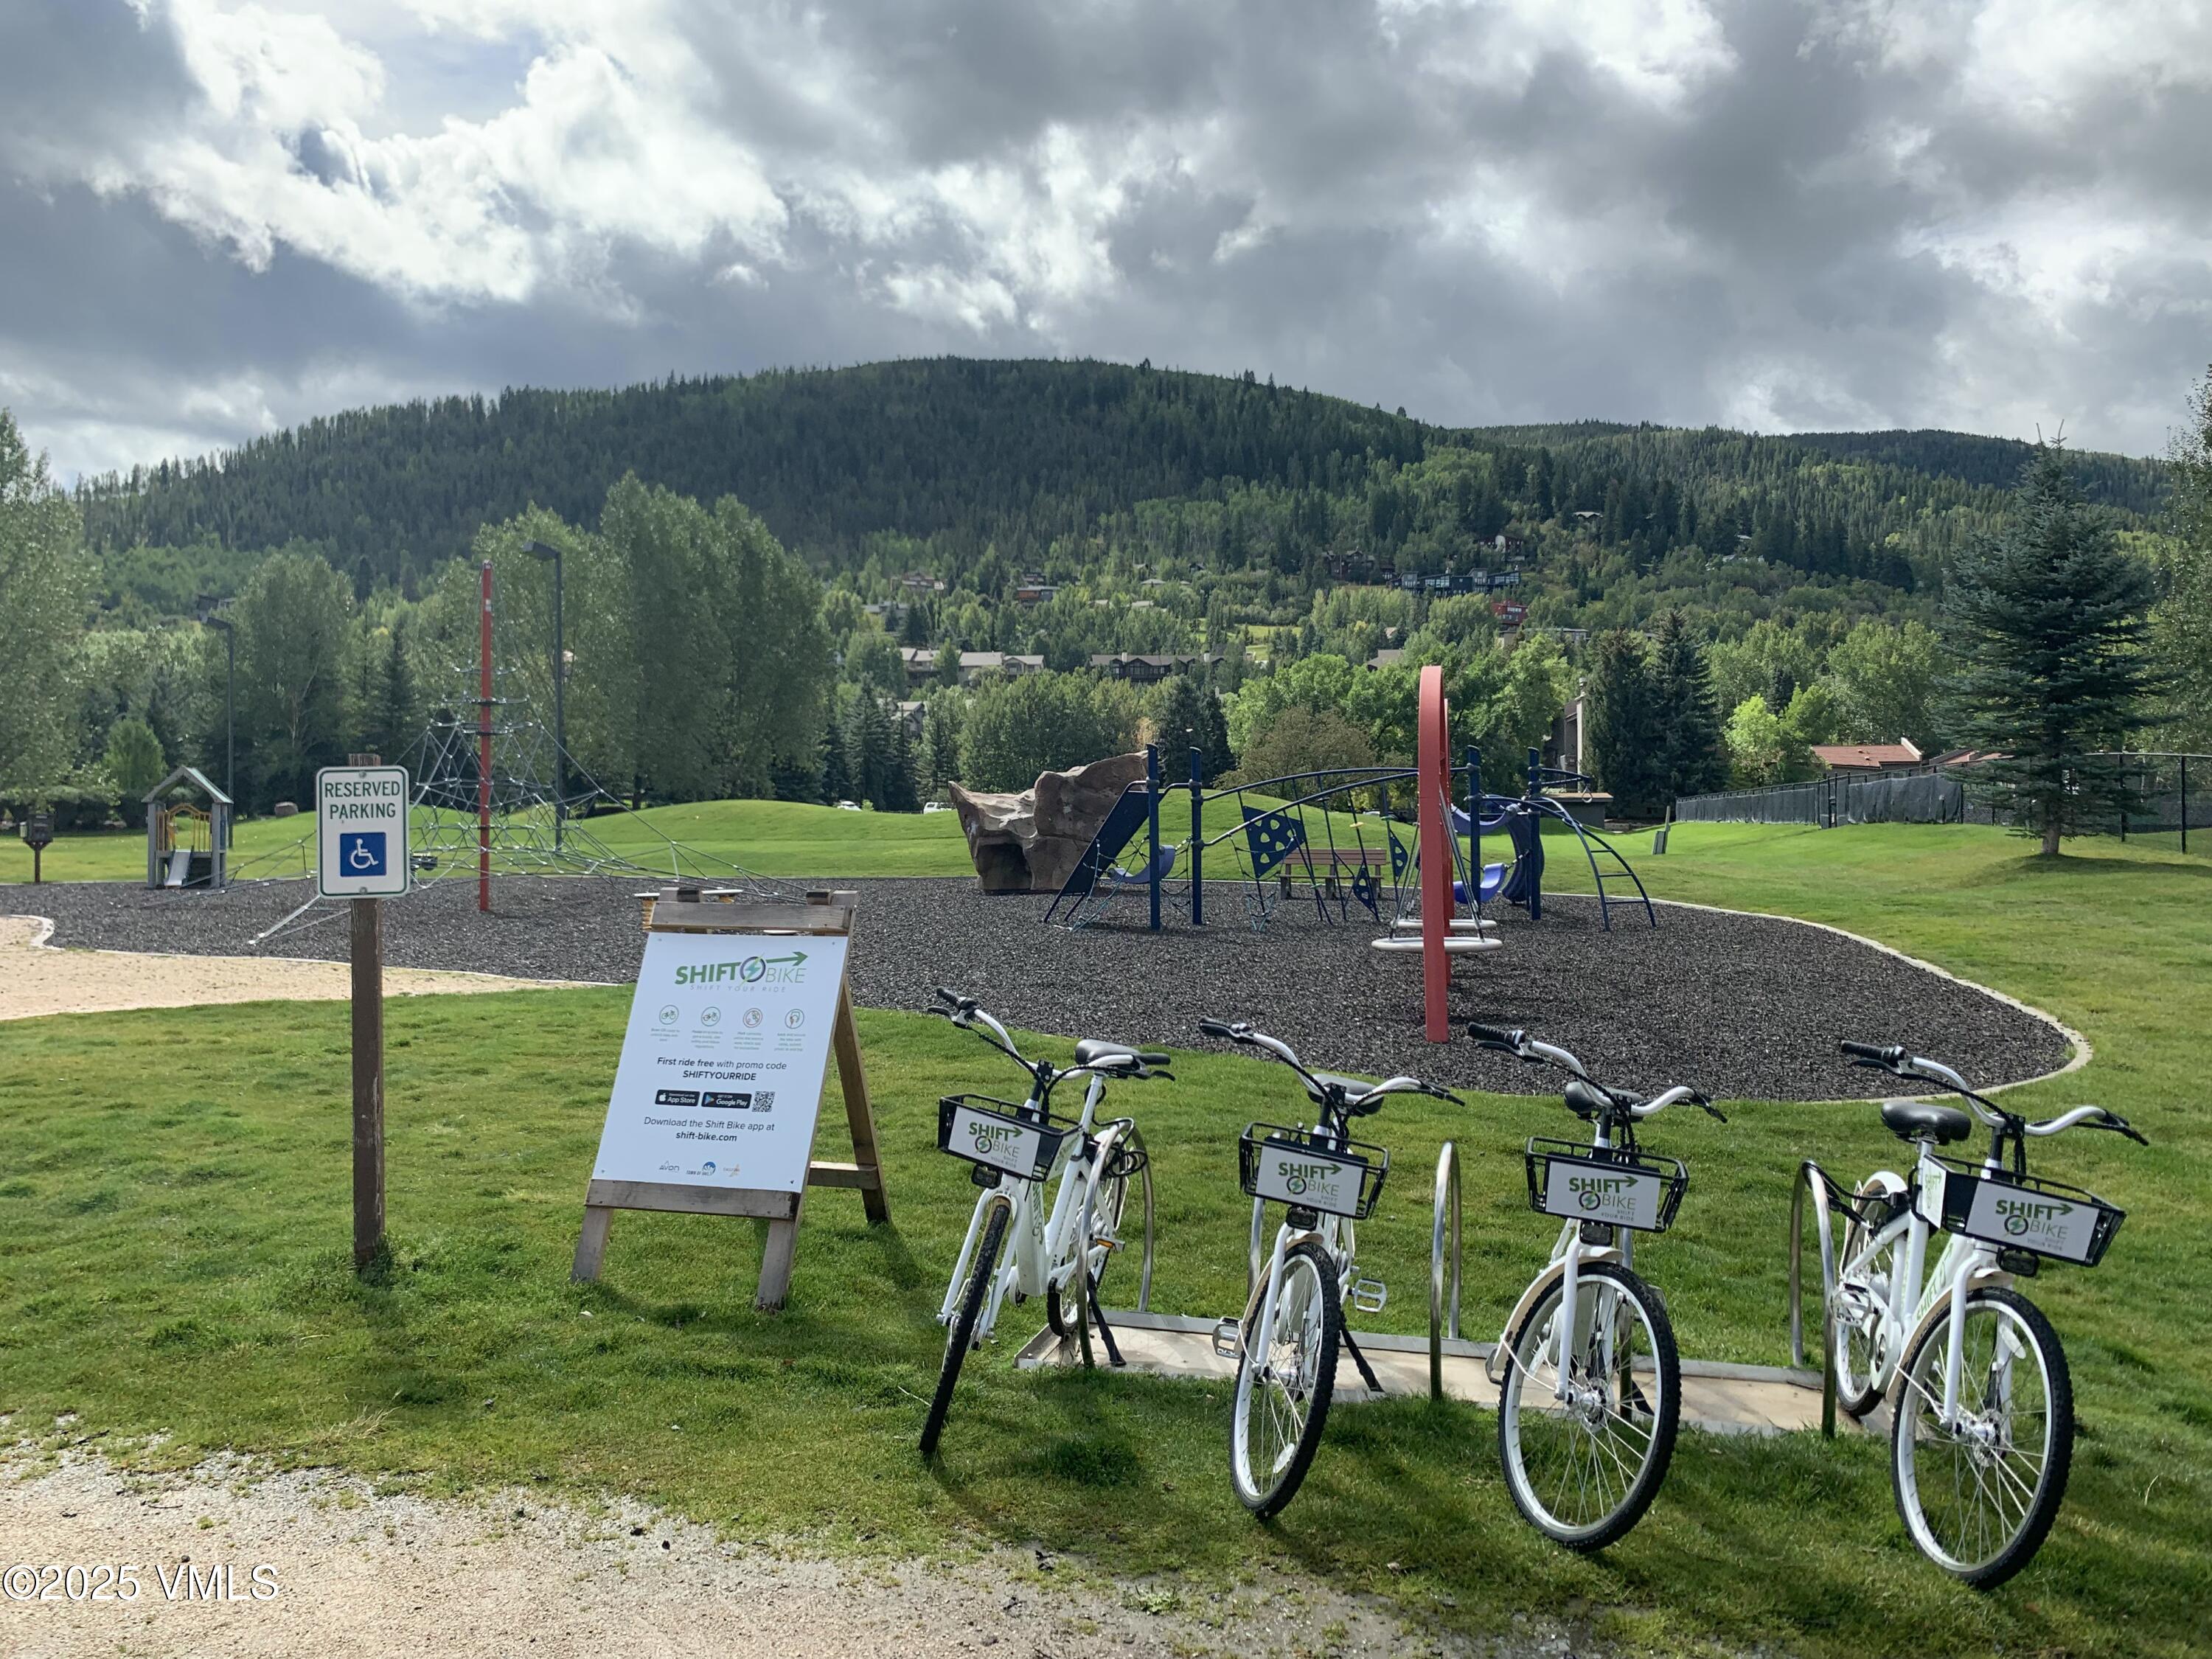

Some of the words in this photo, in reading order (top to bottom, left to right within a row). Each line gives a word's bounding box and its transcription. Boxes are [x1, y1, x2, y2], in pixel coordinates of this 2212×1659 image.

[324, 781, 400, 798] RESERVED
[330, 803, 396, 819] PARKING
[675, 961, 742, 985] SHIFT
[765, 967, 807, 984] BIKE
[657, 1057, 677, 1065] First
[678, 1058, 695, 1066] ride
[697, 1059, 714, 1067] free
[717, 1060, 734, 1068] with
[736, 1062, 763, 1070] promo
[766, 1062, 787, 1070] code
[683, 1071, 757, 1081] SHIFTYOURRIDE
[716, 1099, 736, 1107] Google
[644, 1116, 687, 1127] Download
[689, 1119, 703, 1127] the
[705, 1120, 725, 1129] Shift
[727, 1121, 745, 1130] Bike
[748, 1123, 764, 1132] app
[969, 1121, 1010, 1141] SHIFT
[675, 1132, 737, 1141] shift-bike.com
[992, 1140, 1020, 1158] BIKE
[1278, 1162, 1327, 1180] SHIFT
[1307, 1180, 1339, 1197] BIKE
[1568, 1177, 1622, 1193] SHIFT
[1601, 1194, 1636, 1210] BIKE
[1995, 1200, 2055, 1220] SHIFT
[2030, 1220, 2068, 1239] BIKE
[1917, 1278, 1937, 1321] SHIFT
